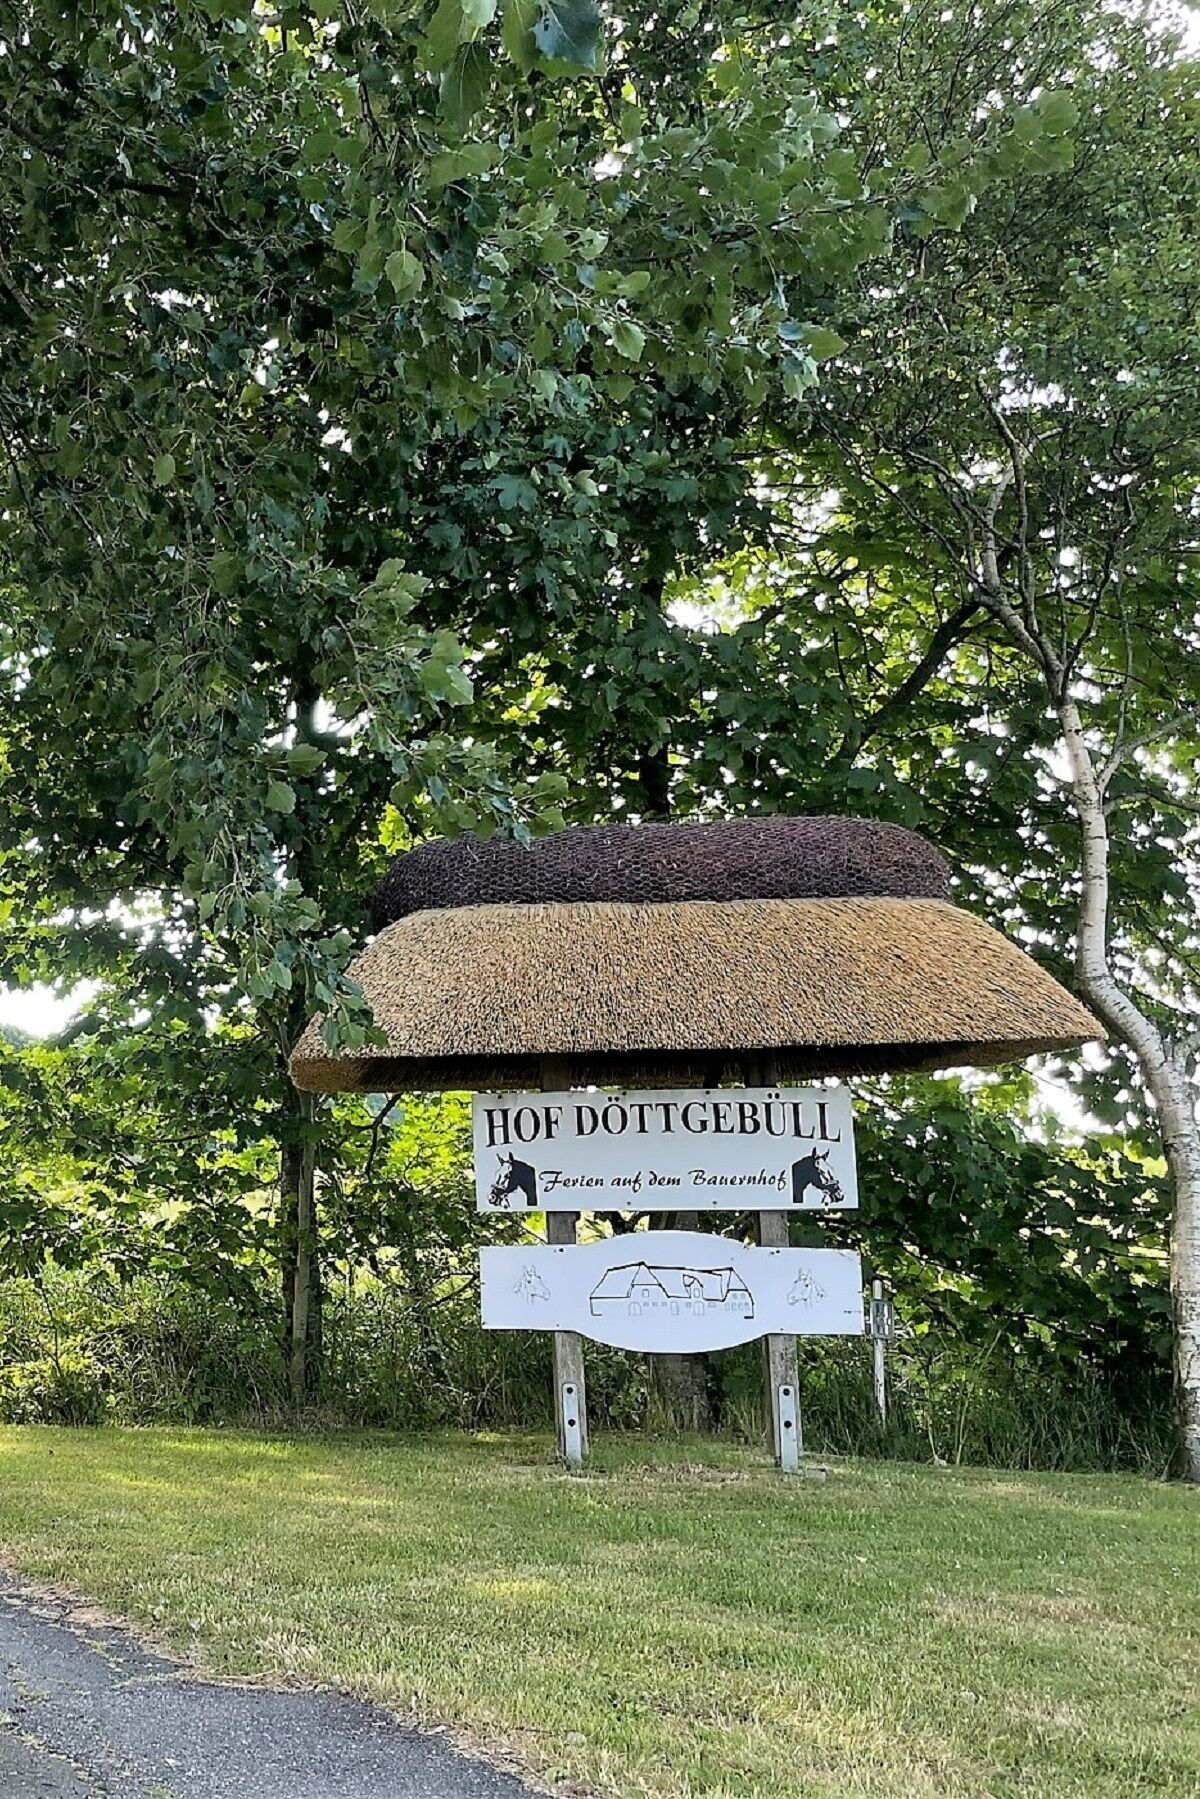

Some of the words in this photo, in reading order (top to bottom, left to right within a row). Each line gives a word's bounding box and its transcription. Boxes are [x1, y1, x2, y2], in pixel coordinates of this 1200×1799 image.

[483, 1106, 563, 1147] HOF
[573, 1092, 841, 1142] DÖTTGEBÜLL
[539, 1170, 604, 1192] Ferien
[611, 1171, 642, 1193] auf
[649, 1171, 681, 1186] dem
[688, 1169, 787, 1191] Bauernhof
